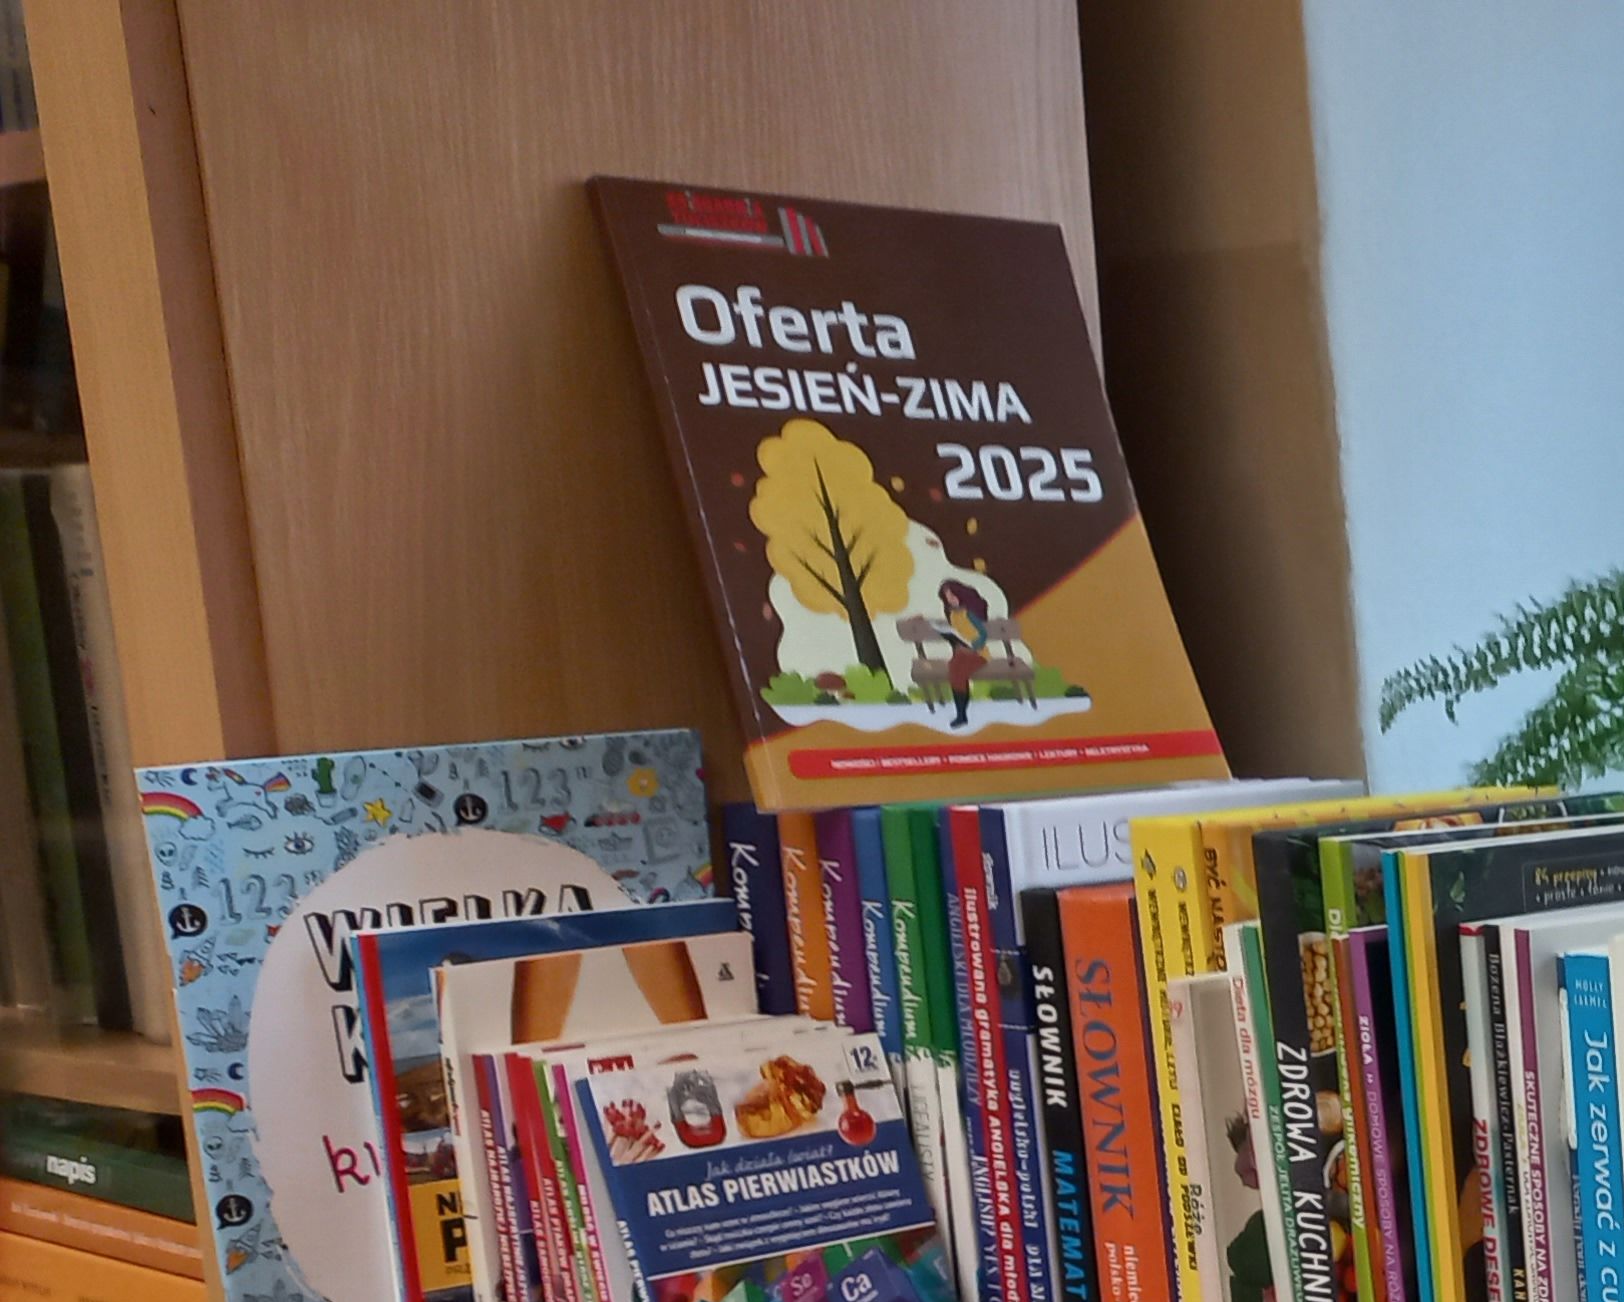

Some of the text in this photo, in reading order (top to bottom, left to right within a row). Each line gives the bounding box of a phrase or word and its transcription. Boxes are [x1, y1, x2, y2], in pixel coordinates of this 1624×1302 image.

[675, 283, 915, 361] Oferta
[698, 361, 1031, 425] JESIEŃ-ZIMA
[936, 442, 1103, 503] 2025
[1032, 965, 1067, 1108] SŁOWNIK
[1584, 1031, 1611, 1094] Jak
[1075, 956, 1135, 1216] SŁOWNIK
[1277, 1041, 1318, 1163] ZDROWA
[46, 1155, 97, 1185] napis
[647, 1148, 899, 1217] ATLAS PIERWIASTKÓW
[1588, 1101, 1621, 1230] zerwać
[841, 1271, 873, 1301] Ca
